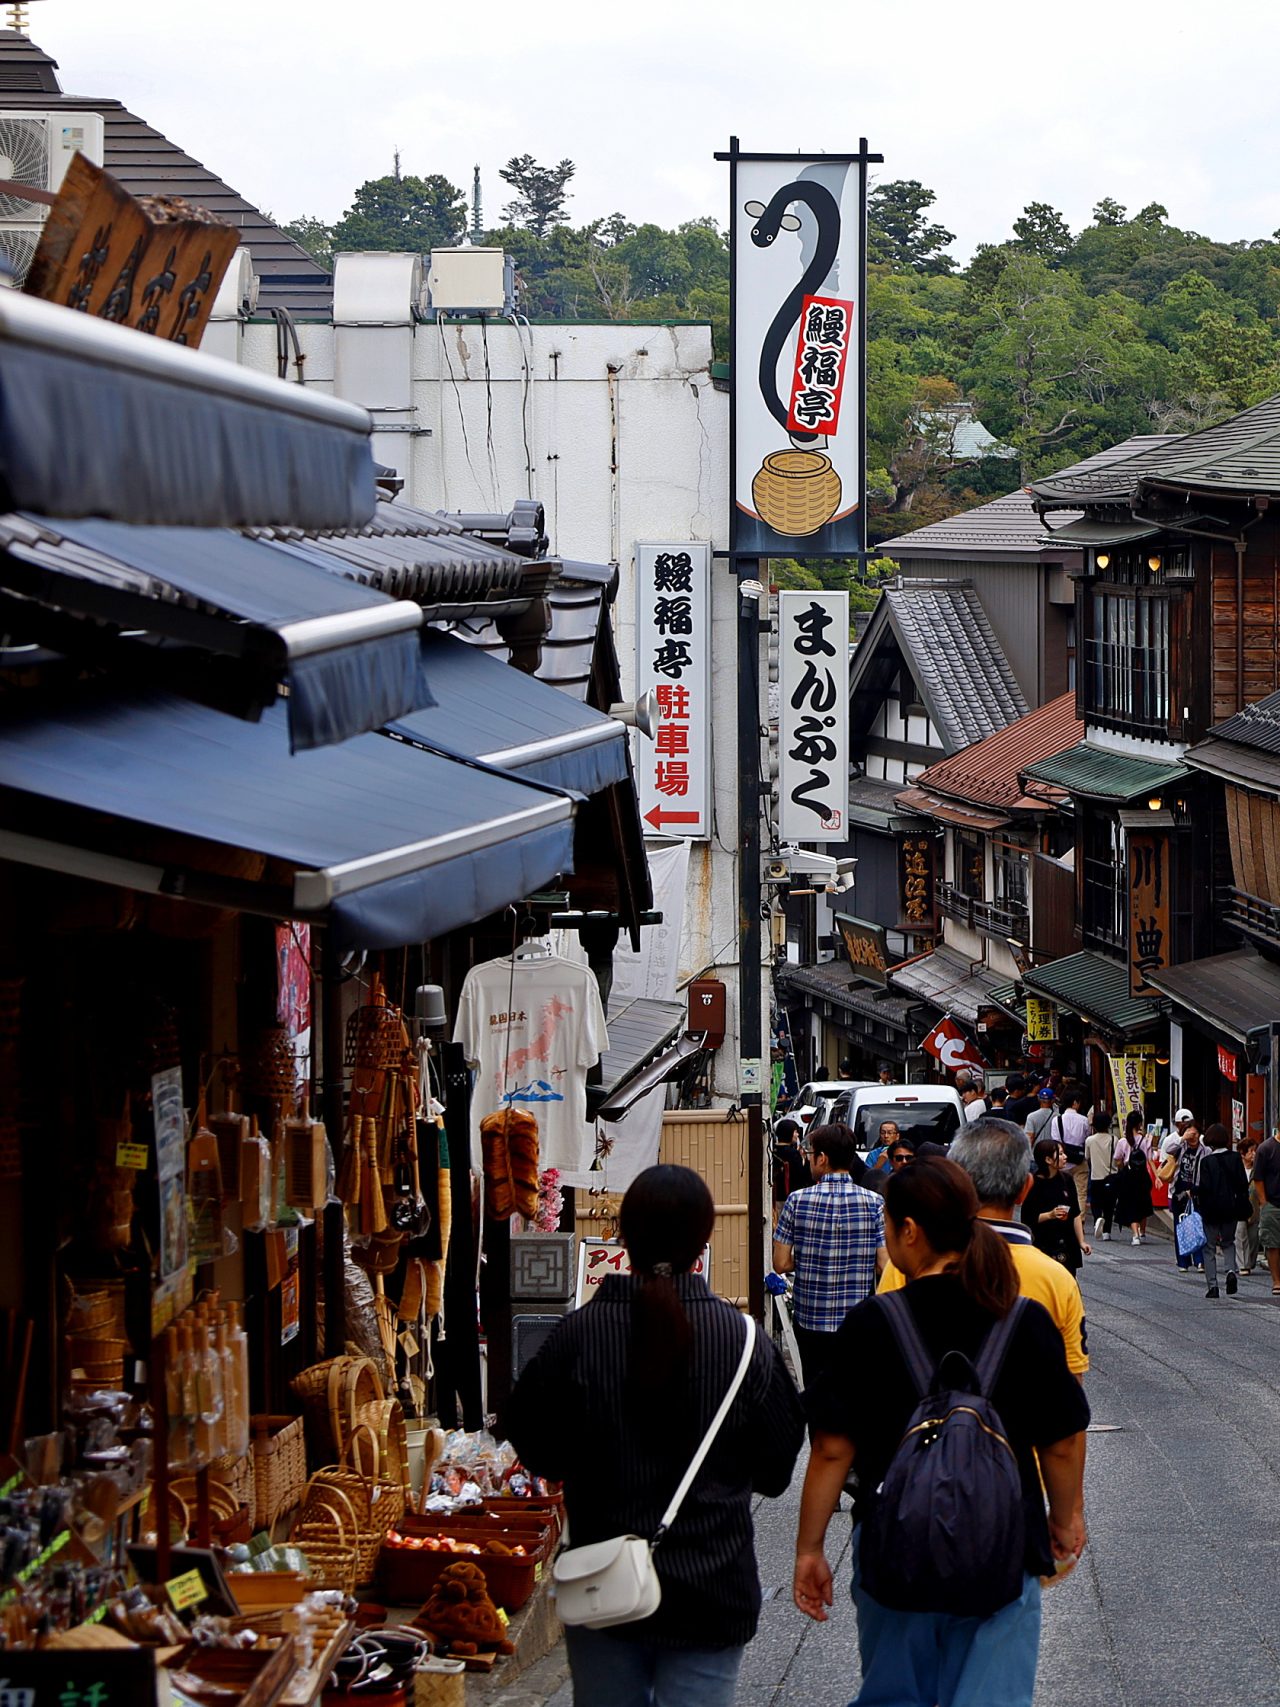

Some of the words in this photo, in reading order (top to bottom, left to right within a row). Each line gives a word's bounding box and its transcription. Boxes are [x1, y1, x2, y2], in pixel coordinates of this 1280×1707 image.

[796, 304, 845, 427] 鰻福亭
[652, 552, 694, 680] 鰻福亭
[654, 683, 691, 797] 駐車場
[787, 600, 838, 823] まんぷく
